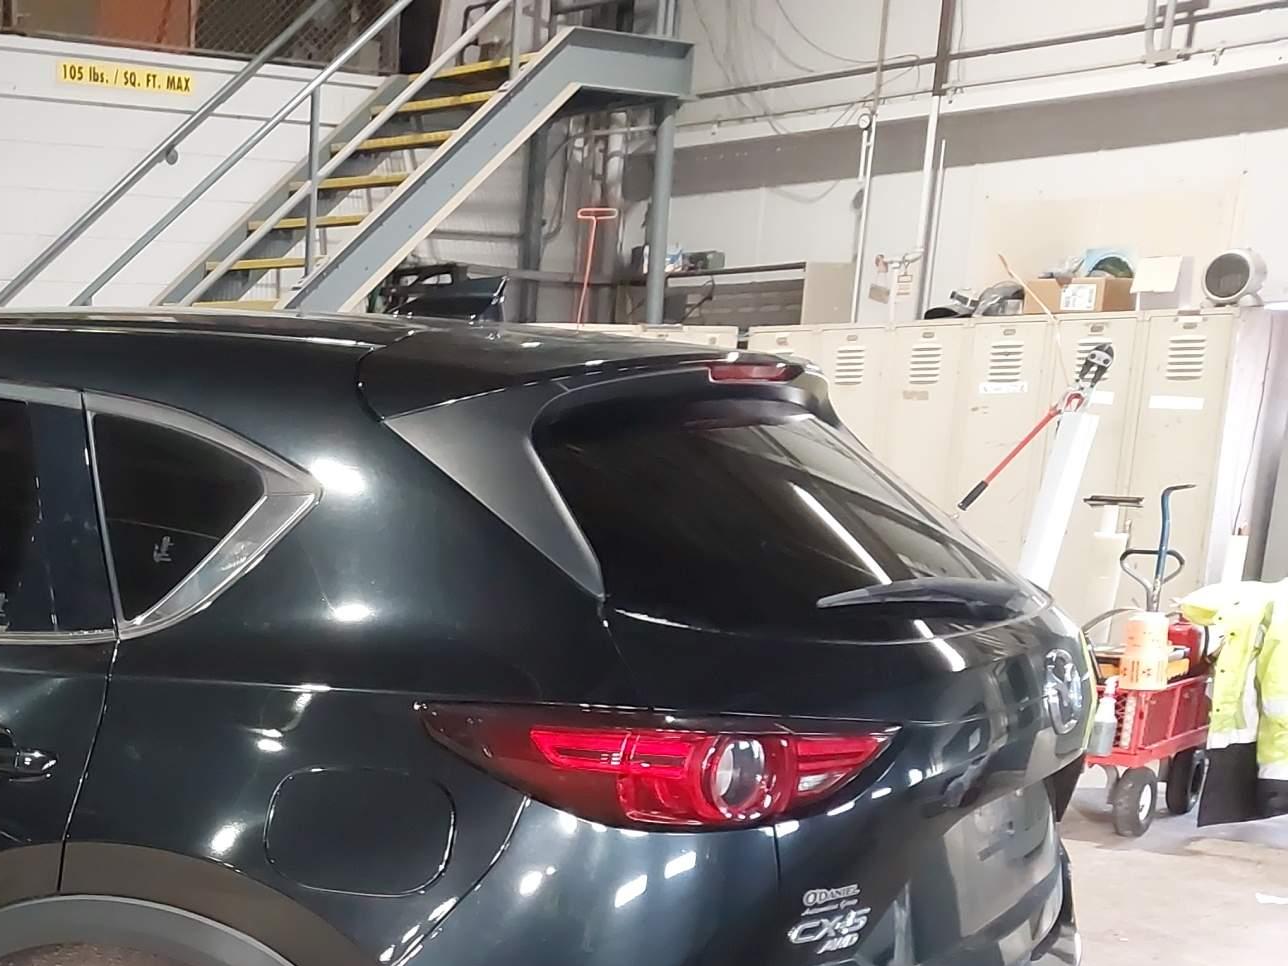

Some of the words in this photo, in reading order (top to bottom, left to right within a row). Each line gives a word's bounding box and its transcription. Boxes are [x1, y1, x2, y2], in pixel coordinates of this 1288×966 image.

[62, 63, 84, 81] 105
[88, 66, 109, 84] lbs.
[123, 70, 141, 88] SQ.
[146, 73, 162, 89] FT.
[166, 75, 191, 92] MAX
[789, 908, 871, 944] CX-5
[816, 933, 859, 954] AWD
